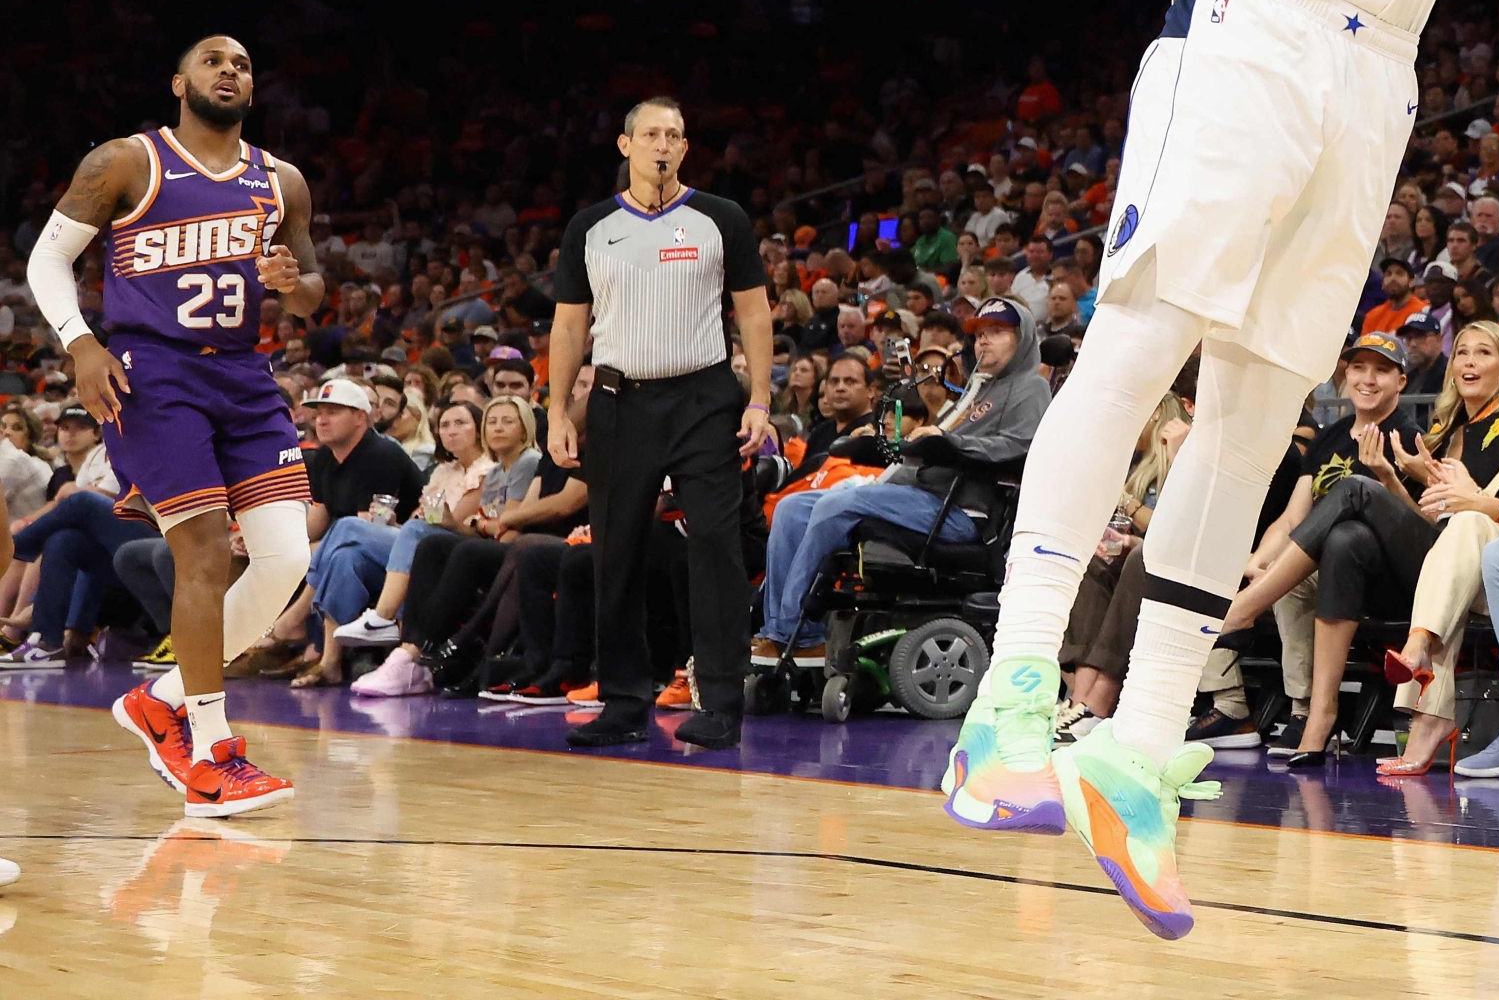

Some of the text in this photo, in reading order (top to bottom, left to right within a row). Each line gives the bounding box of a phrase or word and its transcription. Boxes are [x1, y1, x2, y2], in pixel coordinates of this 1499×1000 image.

[238, 176, 270, 190] PayPal
[134, 217, 257, 272] SUNS
[660, 249, 699, 261] Emirates
[177, 273, 246, 329] 23
[278, 446, 304, 466] PHO
